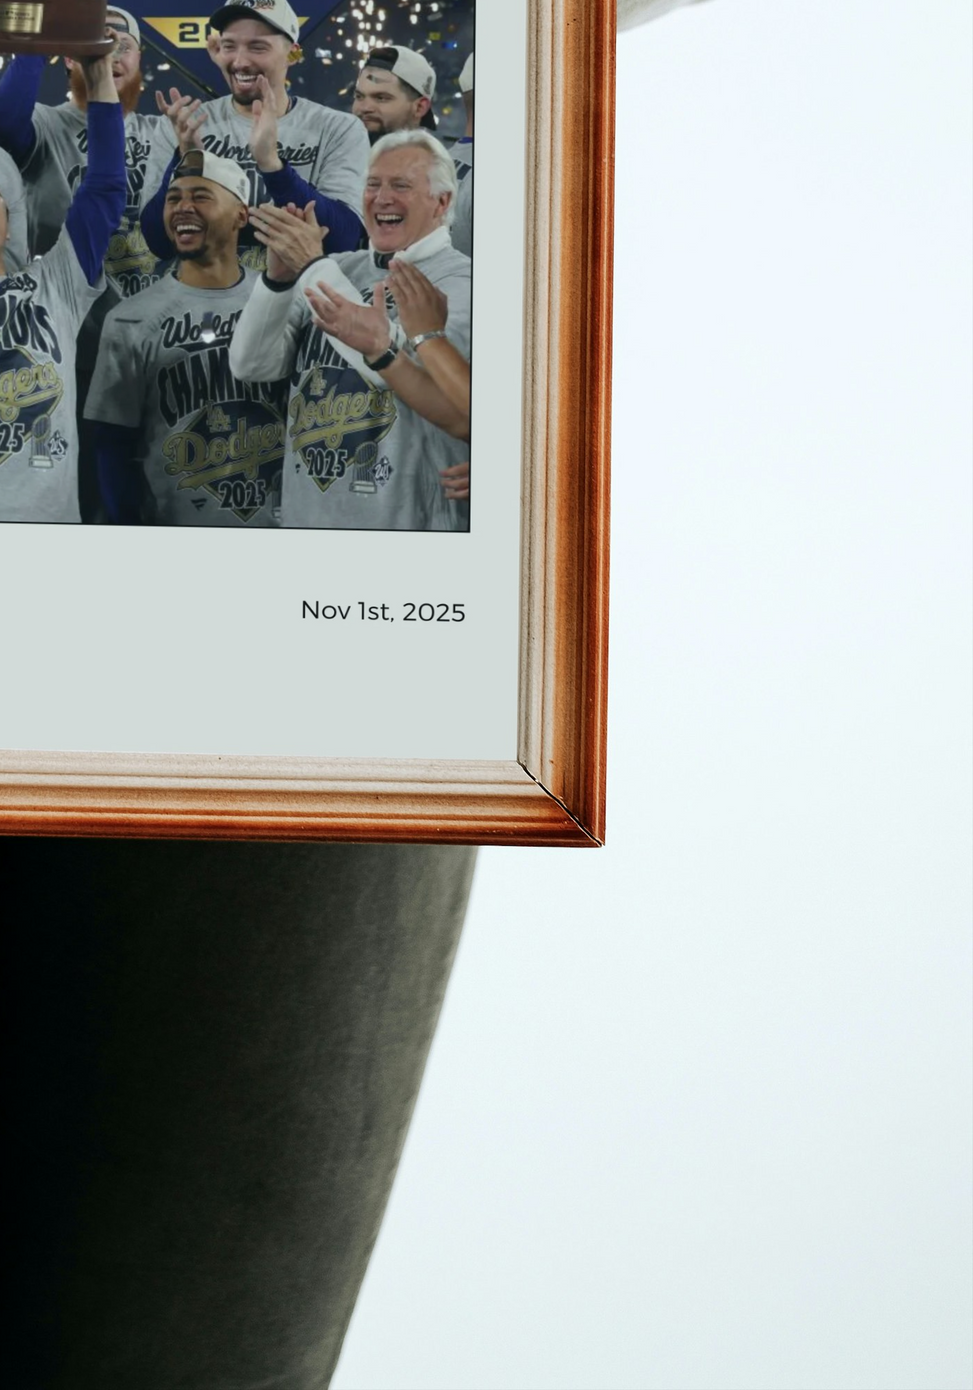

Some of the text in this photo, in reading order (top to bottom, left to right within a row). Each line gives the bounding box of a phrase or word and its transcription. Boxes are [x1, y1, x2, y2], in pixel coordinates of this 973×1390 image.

[160, 309, 236, 349] Wold
[218, 480, 266, 510] 2025
[302, 600, 466, 623] Nov 1st, 2025
